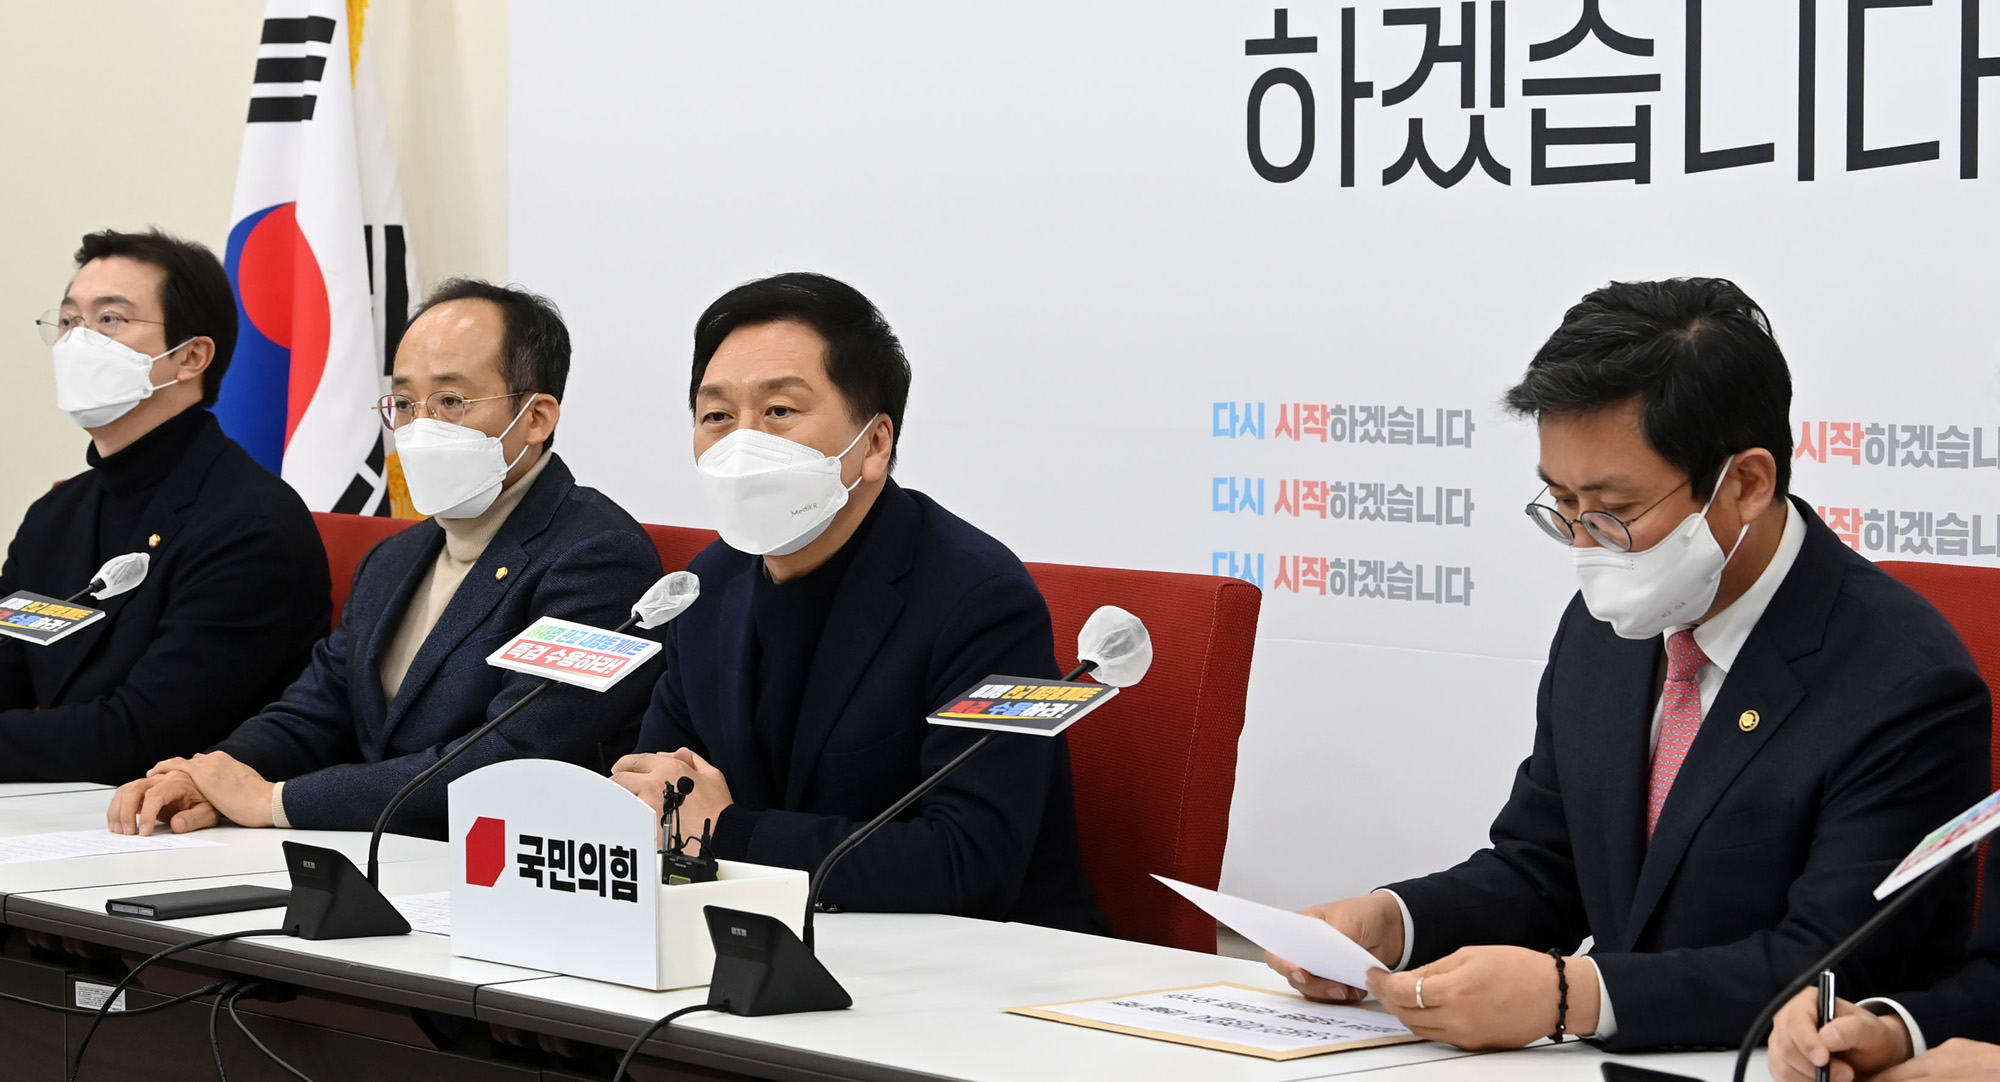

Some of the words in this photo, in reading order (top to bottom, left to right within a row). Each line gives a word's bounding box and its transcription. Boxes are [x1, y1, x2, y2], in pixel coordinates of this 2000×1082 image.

[1245, 0, 2000, 188] 하겠습니다
[1213, 401, 1265, 440] 다시
[1275, 403, 1475, 448] 시작하겠습니다
[1212, 476, 1265, 516] 다시
[1274, 479, 1475, 527] 시작하겠습니다
[1818, 506, 2000, 557] 작하겠습니
[1274, 555, 1475, 606] 시작하겠습니다
[507, 641, 552, 661] 특검
[544, 648, 626, 675] 수용하라!
[988, 701, 1079, 719] 수용하라!
[516, 833, 639, 904] 국민의힘
